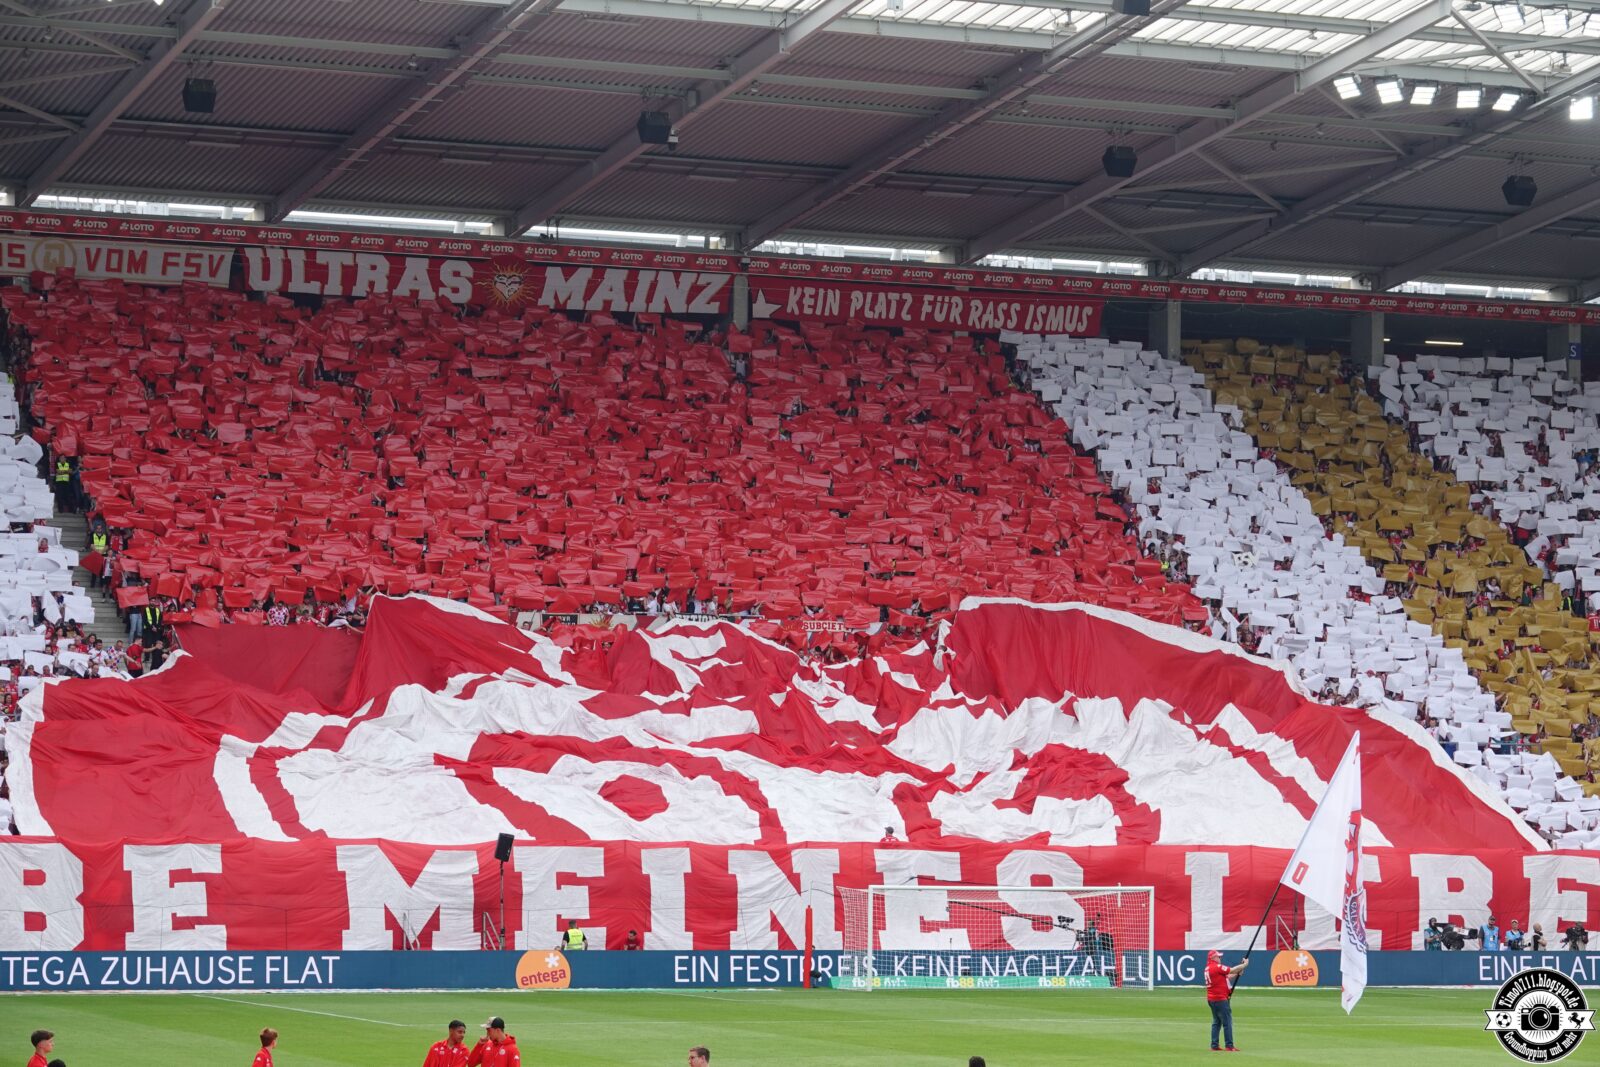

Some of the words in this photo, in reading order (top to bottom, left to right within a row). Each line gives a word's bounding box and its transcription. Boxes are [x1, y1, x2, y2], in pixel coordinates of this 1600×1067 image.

[85, 247, 148, 274] VOM
[161, 253, 225, 279] FSV
[246, 247, 474, 305] ULTRAS
[538, 266, 734, 314] MAINZ
[786, 286, 841, 317] KEIN
[850, 291, 913, 321] PLATZ
[920, 294, 964, 325] FÜR
[0, 842, 228, 951] BE
[336, 844, 1085, 951] MEINES
[2, 956, 90, 986] TEGA
[101, 955, 254, 985] ZUHAUSE
[266, 955, 340, 985] FLAT
[521, 969, 567, 986] entega
[674, 955, 719, 983] EIN
[946, 977, 974, 988] fb88
[1038, 977, 1067, 988] fb88
[1275, 968, 1315, 984] entega
